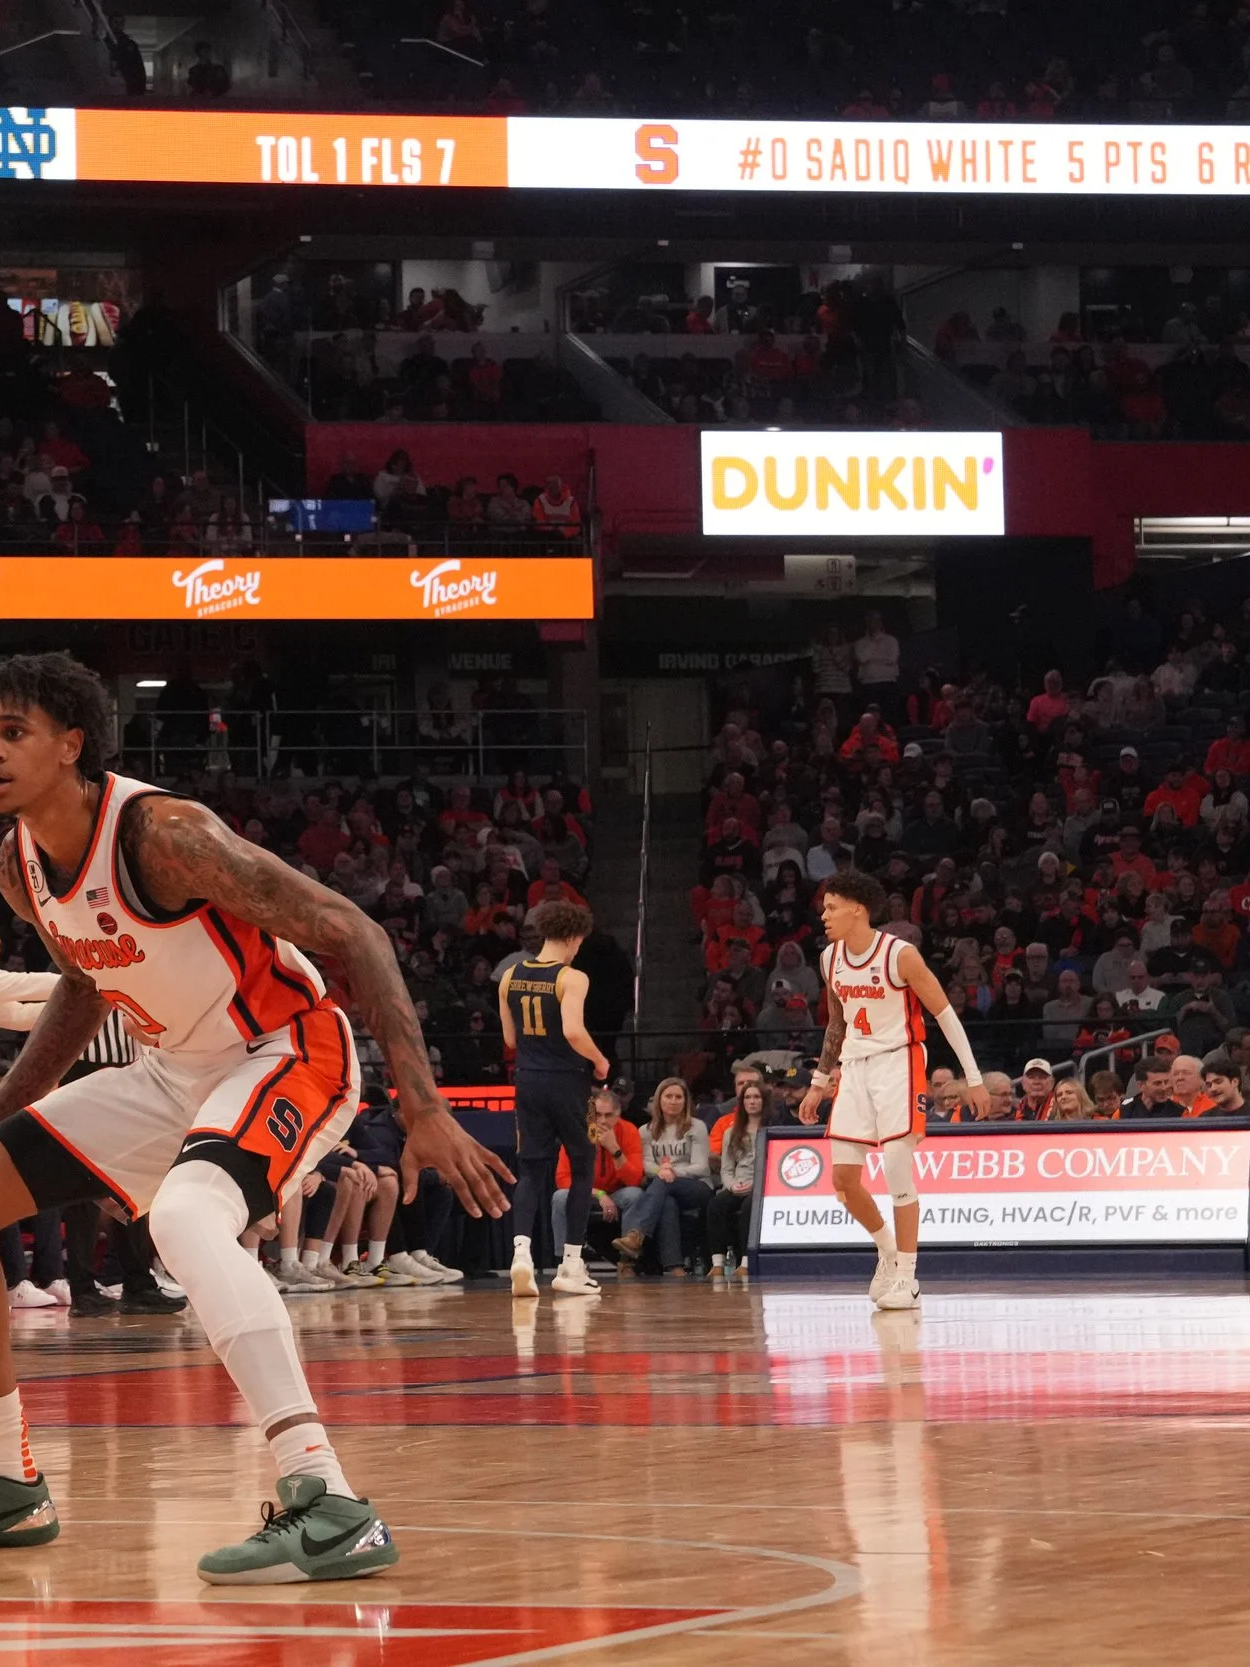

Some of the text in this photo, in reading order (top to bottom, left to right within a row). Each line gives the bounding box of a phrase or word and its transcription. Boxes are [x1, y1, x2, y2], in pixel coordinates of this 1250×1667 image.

[256, 135, 455, 184] TOL 1 FLS 7
[635, 124, 679, 184] S
[806, 138, 910, 185] SADIQ
[927, 140, 1037, 184] WHITE
[1069, 141, 1084, 183] 5
[1106, 141, 1166, 185] PTS
[1198, 142, 1214, 185] 6
[711, 456, 994, 511] DUNKIN'
[172, 559, 261, 608] Theory
[410, 559, 497, 608] Theory
[448, 652, 512, 670] VENUE
[835, 980, 886, 1003] Syracuse
[520, 995, 547, 1036] 11
[853, 1007, 872, 1035] 4
[266, 1097, 304, 1152] S
[913, 1150, 1025, 1181] WEBB
[1036, 1146, 1241, 1178] COMPANY
[773, 1201, 1238, 1226] PLUMBI ATING, HVAC/R, PVF & more
[973, 1240, 1019, 1248] DAKTRONICS
